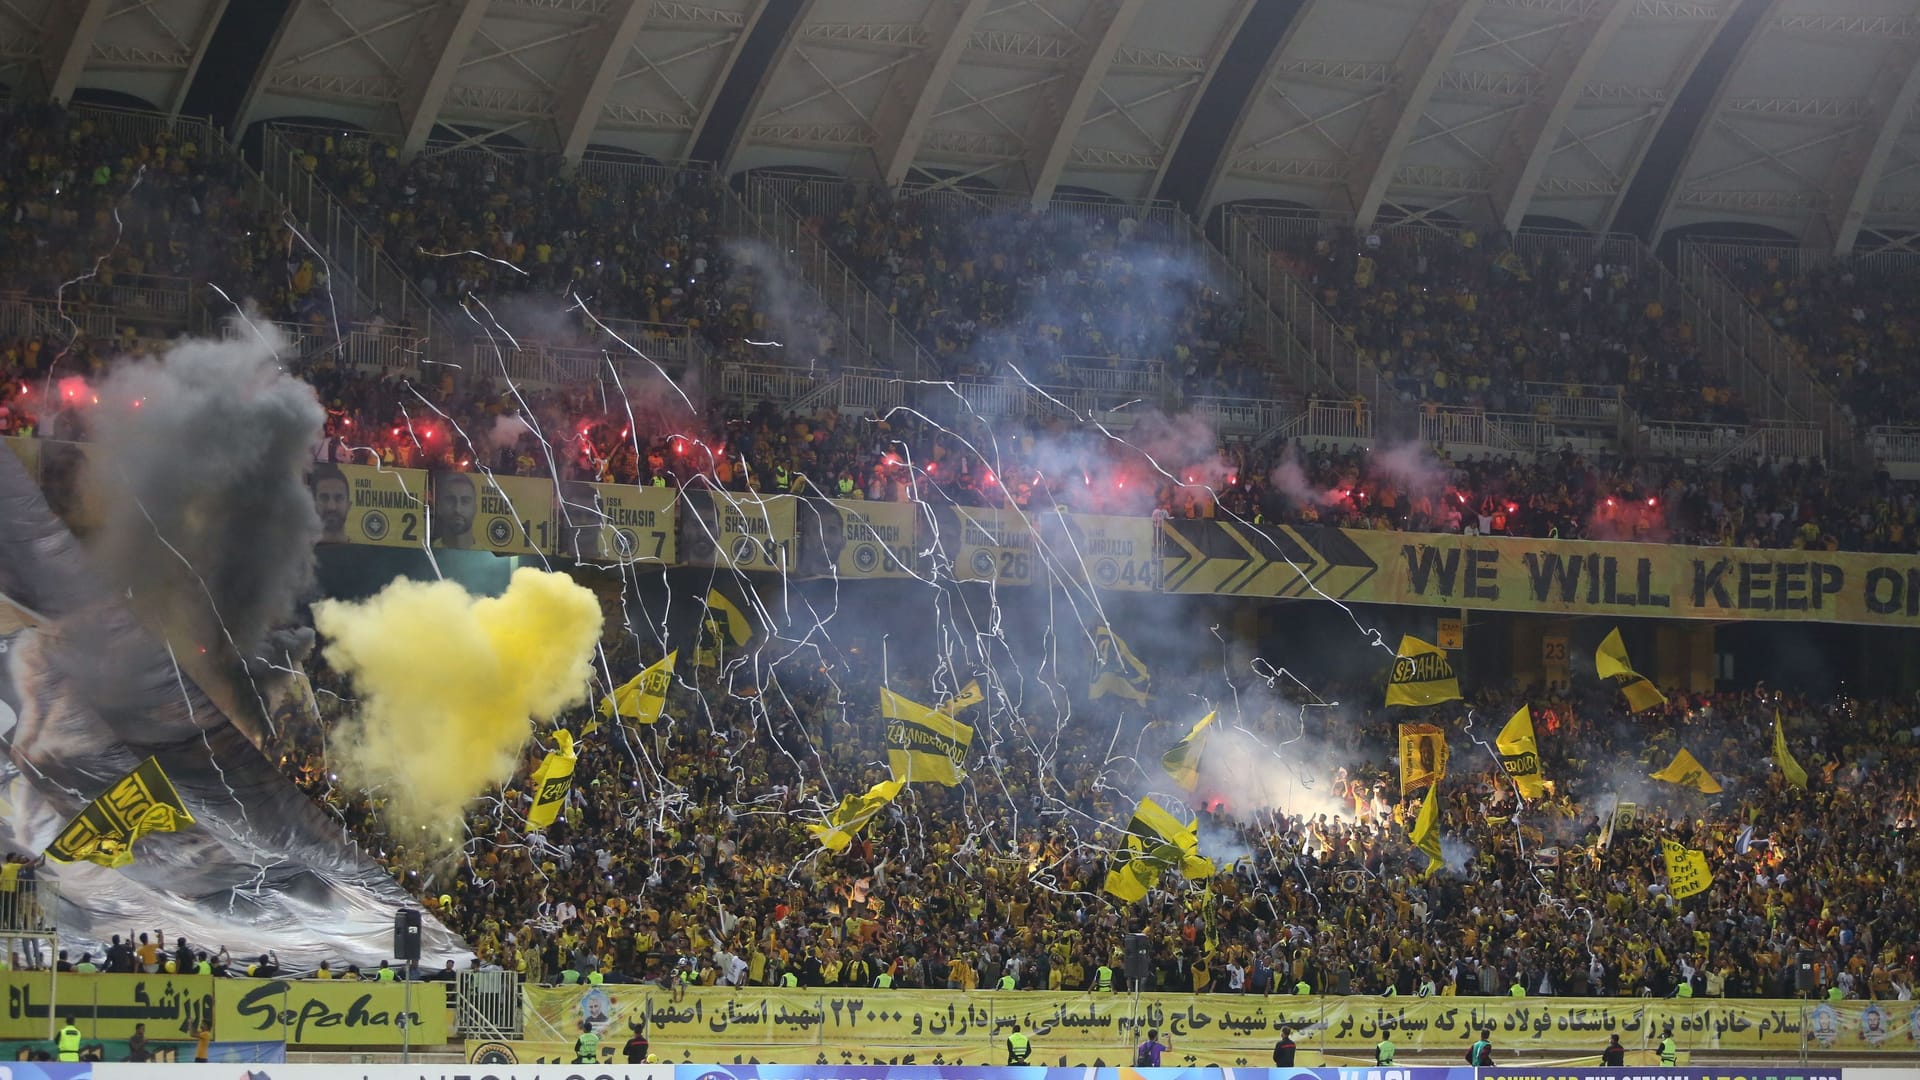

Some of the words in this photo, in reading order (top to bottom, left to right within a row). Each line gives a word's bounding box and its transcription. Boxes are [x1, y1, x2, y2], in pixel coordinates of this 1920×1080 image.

[356, 478, 371, 488] HADI
[356, 490, 418, 509] MOHAMMADI
[607, 497, 621, 506] ISSA
[402, 513, 417, 541] 2
[607, 508, 655, 527] ALEKASIR
[522, 519, 548, 548] 11
[652, 531, 666, 558] 7
[763, 538, 789, 566] 81
[883, 545, 911, 572] 80
[1000, 552, 1028, 579] 26
[1121, 560, 1152, 585] 44
[1401, 544, 1498, 600] WE
[1525, 551, 1670, 607] WILL
[1693, 557, 1844, 610] KEEP
[1546, 643, 1565, 659] 23
[1673, 881, 1699, 896] FAN
[237, 981, 424, 1042] Sepahan
[628, 998, 703, 1031] اصفهان
[709, 998, 768, 1032] استان
[774, 1001, 825, 1030] شهید
[911, 1012, 923, 1035] و
[1118, 1002, 1164, 1035] قاسم
[1170, 1005, 1212, 1036] حاج
[1218, 1008, 1267, 1036] شهید
[1360, 1008, 1428, 1040] سپاهان
[1503, 1007, 1551, 1038] فولاد
[1681, 1008, 1752, 1040] خانواده
[1759, 1009, 1801, 1040] سلام
[1335, 1013, 1354, 1039] بر
